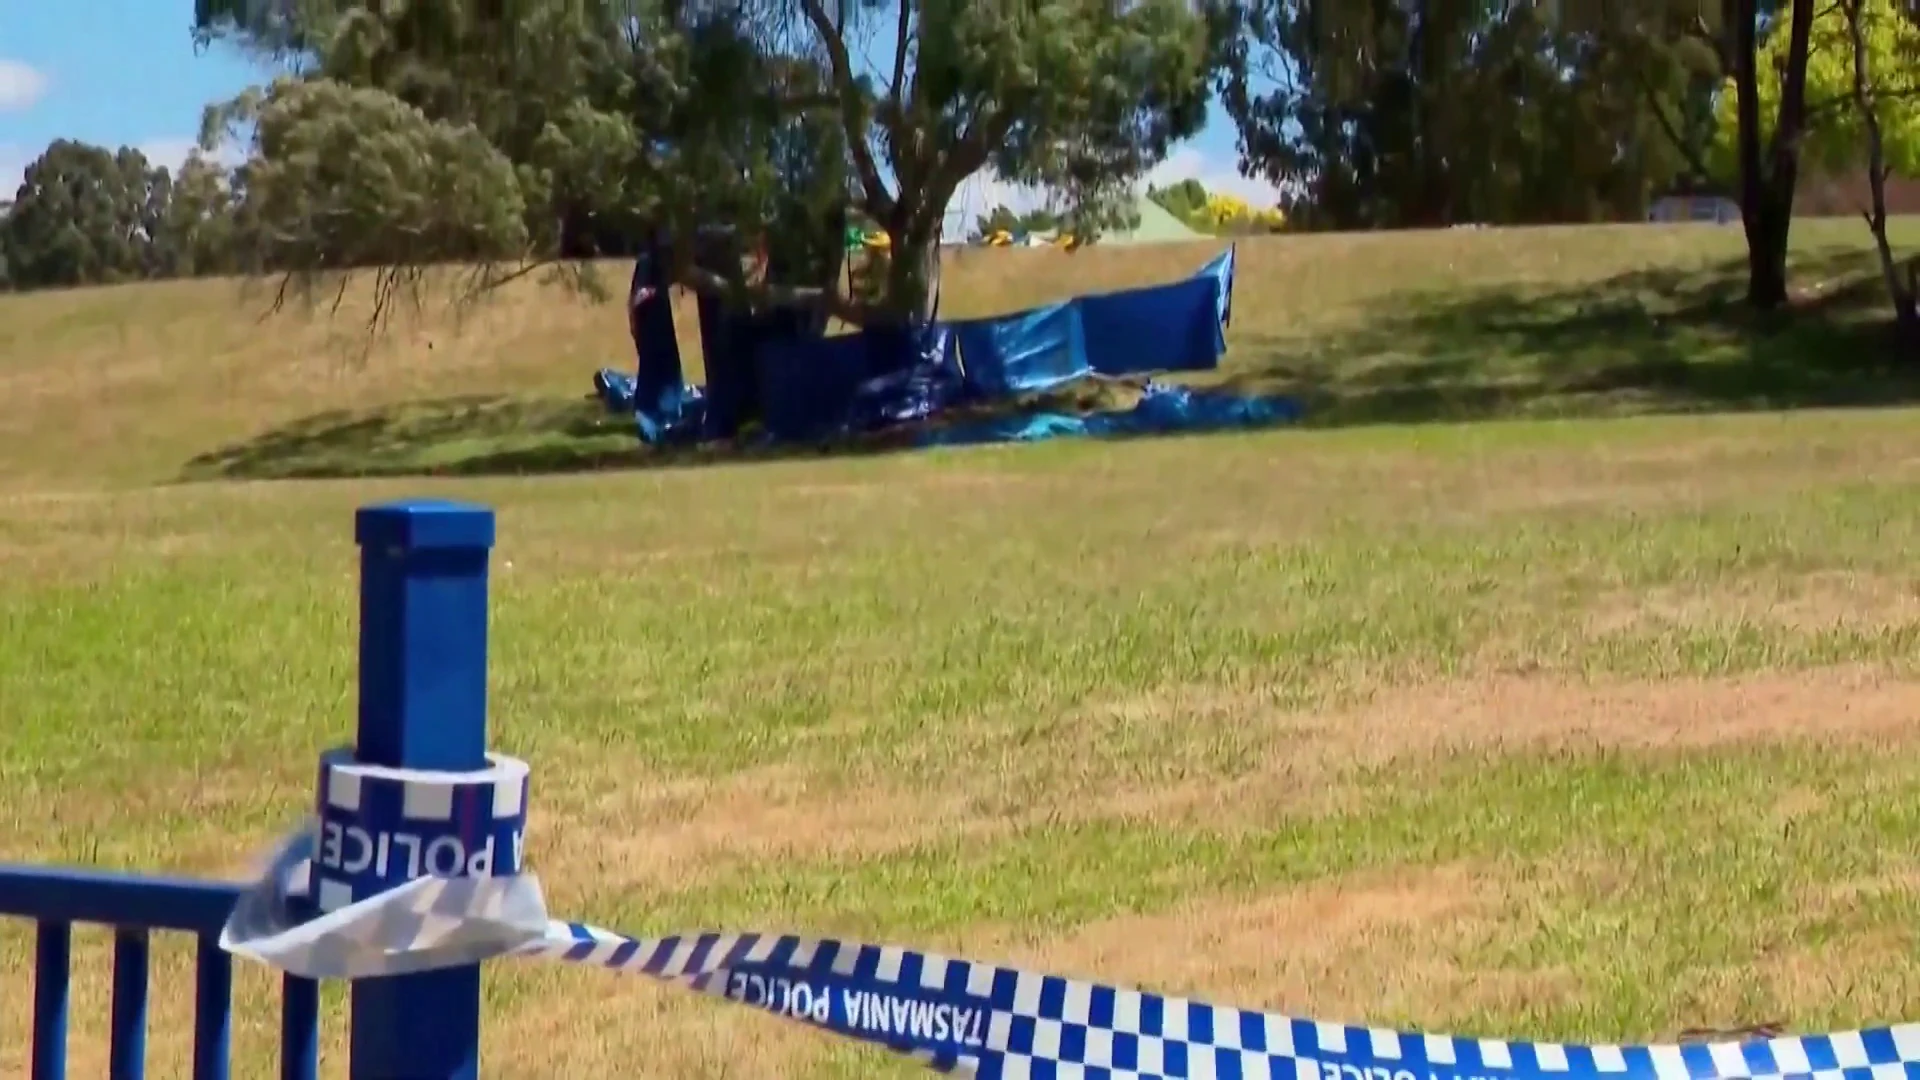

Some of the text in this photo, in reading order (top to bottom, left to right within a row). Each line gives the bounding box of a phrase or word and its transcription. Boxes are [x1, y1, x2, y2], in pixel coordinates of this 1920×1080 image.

[323, 822, 495, 878] POLICE
[731, 971, 982, 1045] TASMANIA POLICE
